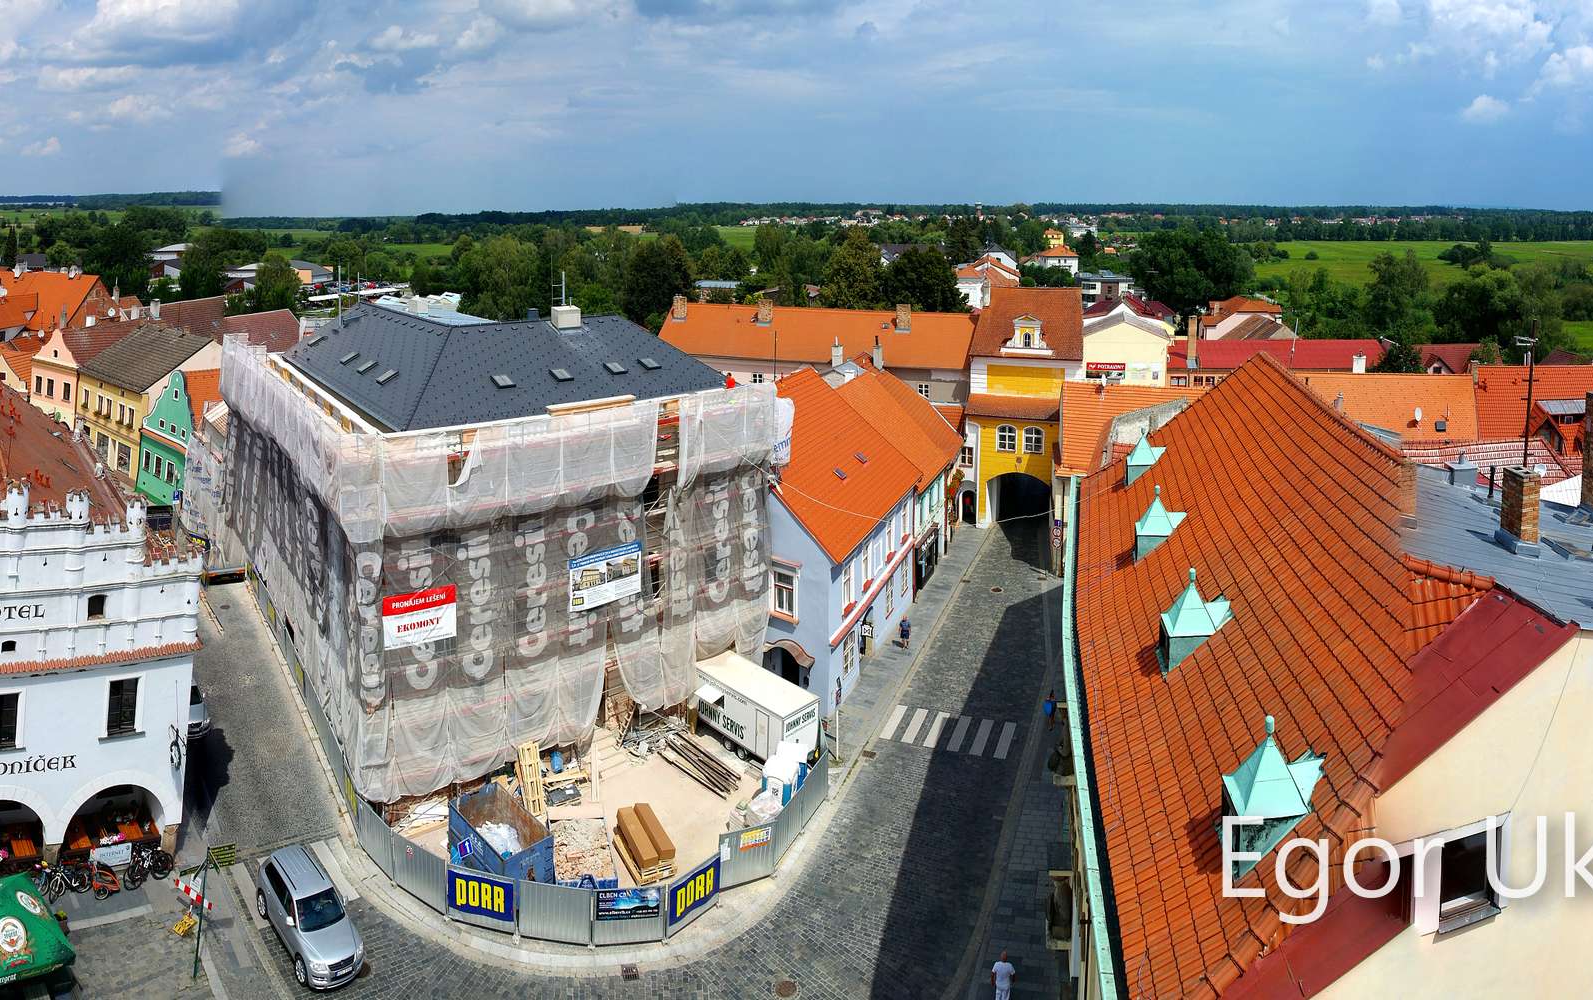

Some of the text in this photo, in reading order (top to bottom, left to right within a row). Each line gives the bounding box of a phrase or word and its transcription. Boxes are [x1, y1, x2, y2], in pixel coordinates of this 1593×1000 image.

[425, 592, 446, 603] LEŠENÍ
[396, 616, 441, 633] EKOMONT
[697, 699, 745, 740] JOHNNY SERVIS
[785, 715, 802, 733] JOHNNY
[801, 707, 816, 724] SERVIS
[455, 877, 505, 914] PORR
[676, 867, 714, 918] PORR
